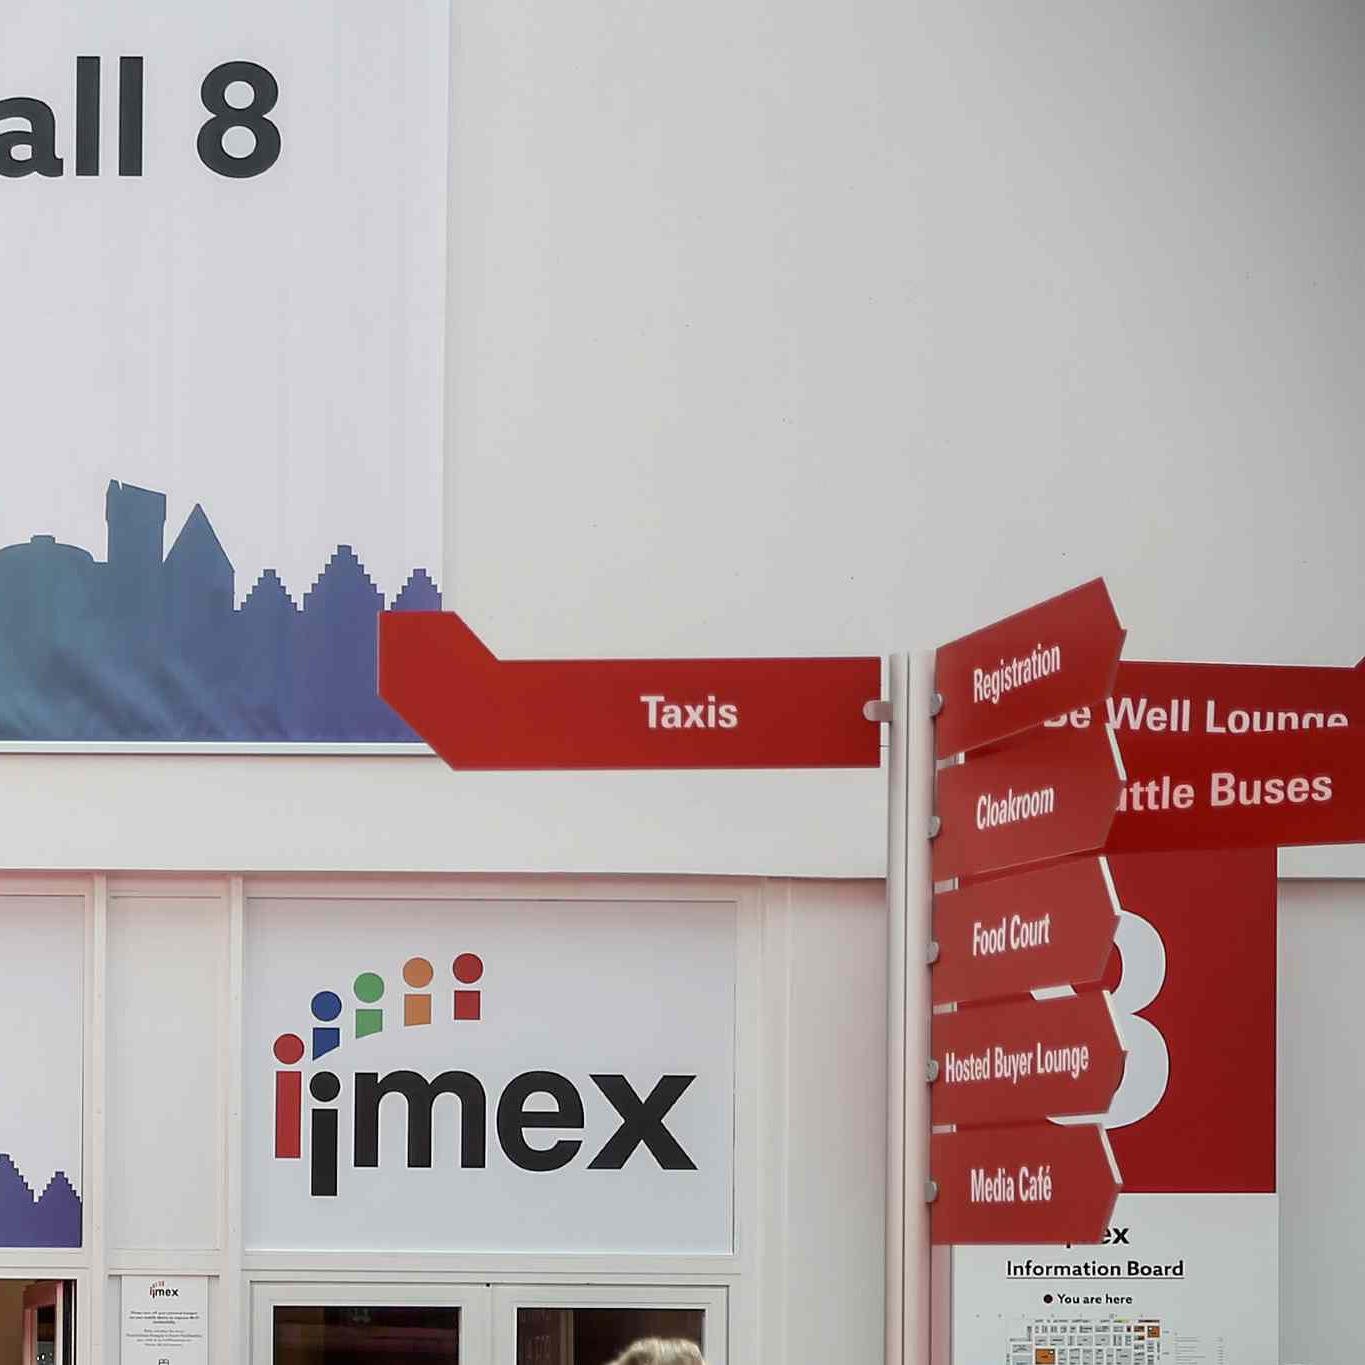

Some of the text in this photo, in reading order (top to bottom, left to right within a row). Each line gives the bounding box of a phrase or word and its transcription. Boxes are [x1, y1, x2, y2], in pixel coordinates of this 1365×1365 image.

[195, 59, 282, 179] 8
[973, 643, 1062, 704] Registration
[640, 695, 739, 730] Taxis
[1105, 696, 1191, 733] Well
[976, 786, 1055, 830] Cloakroom
[1210, 771, 1333, 807] Buses
[972, 913, 1051, 956] Food Court
[945, 1042, 1089, 1085] Hosted Buyer Lounge
[970, 1164, 1053, 1203] Media Café
[1006, 1259, 1185, 1277] Information Board
[1057, 1293, 1133, 1305] You are here
